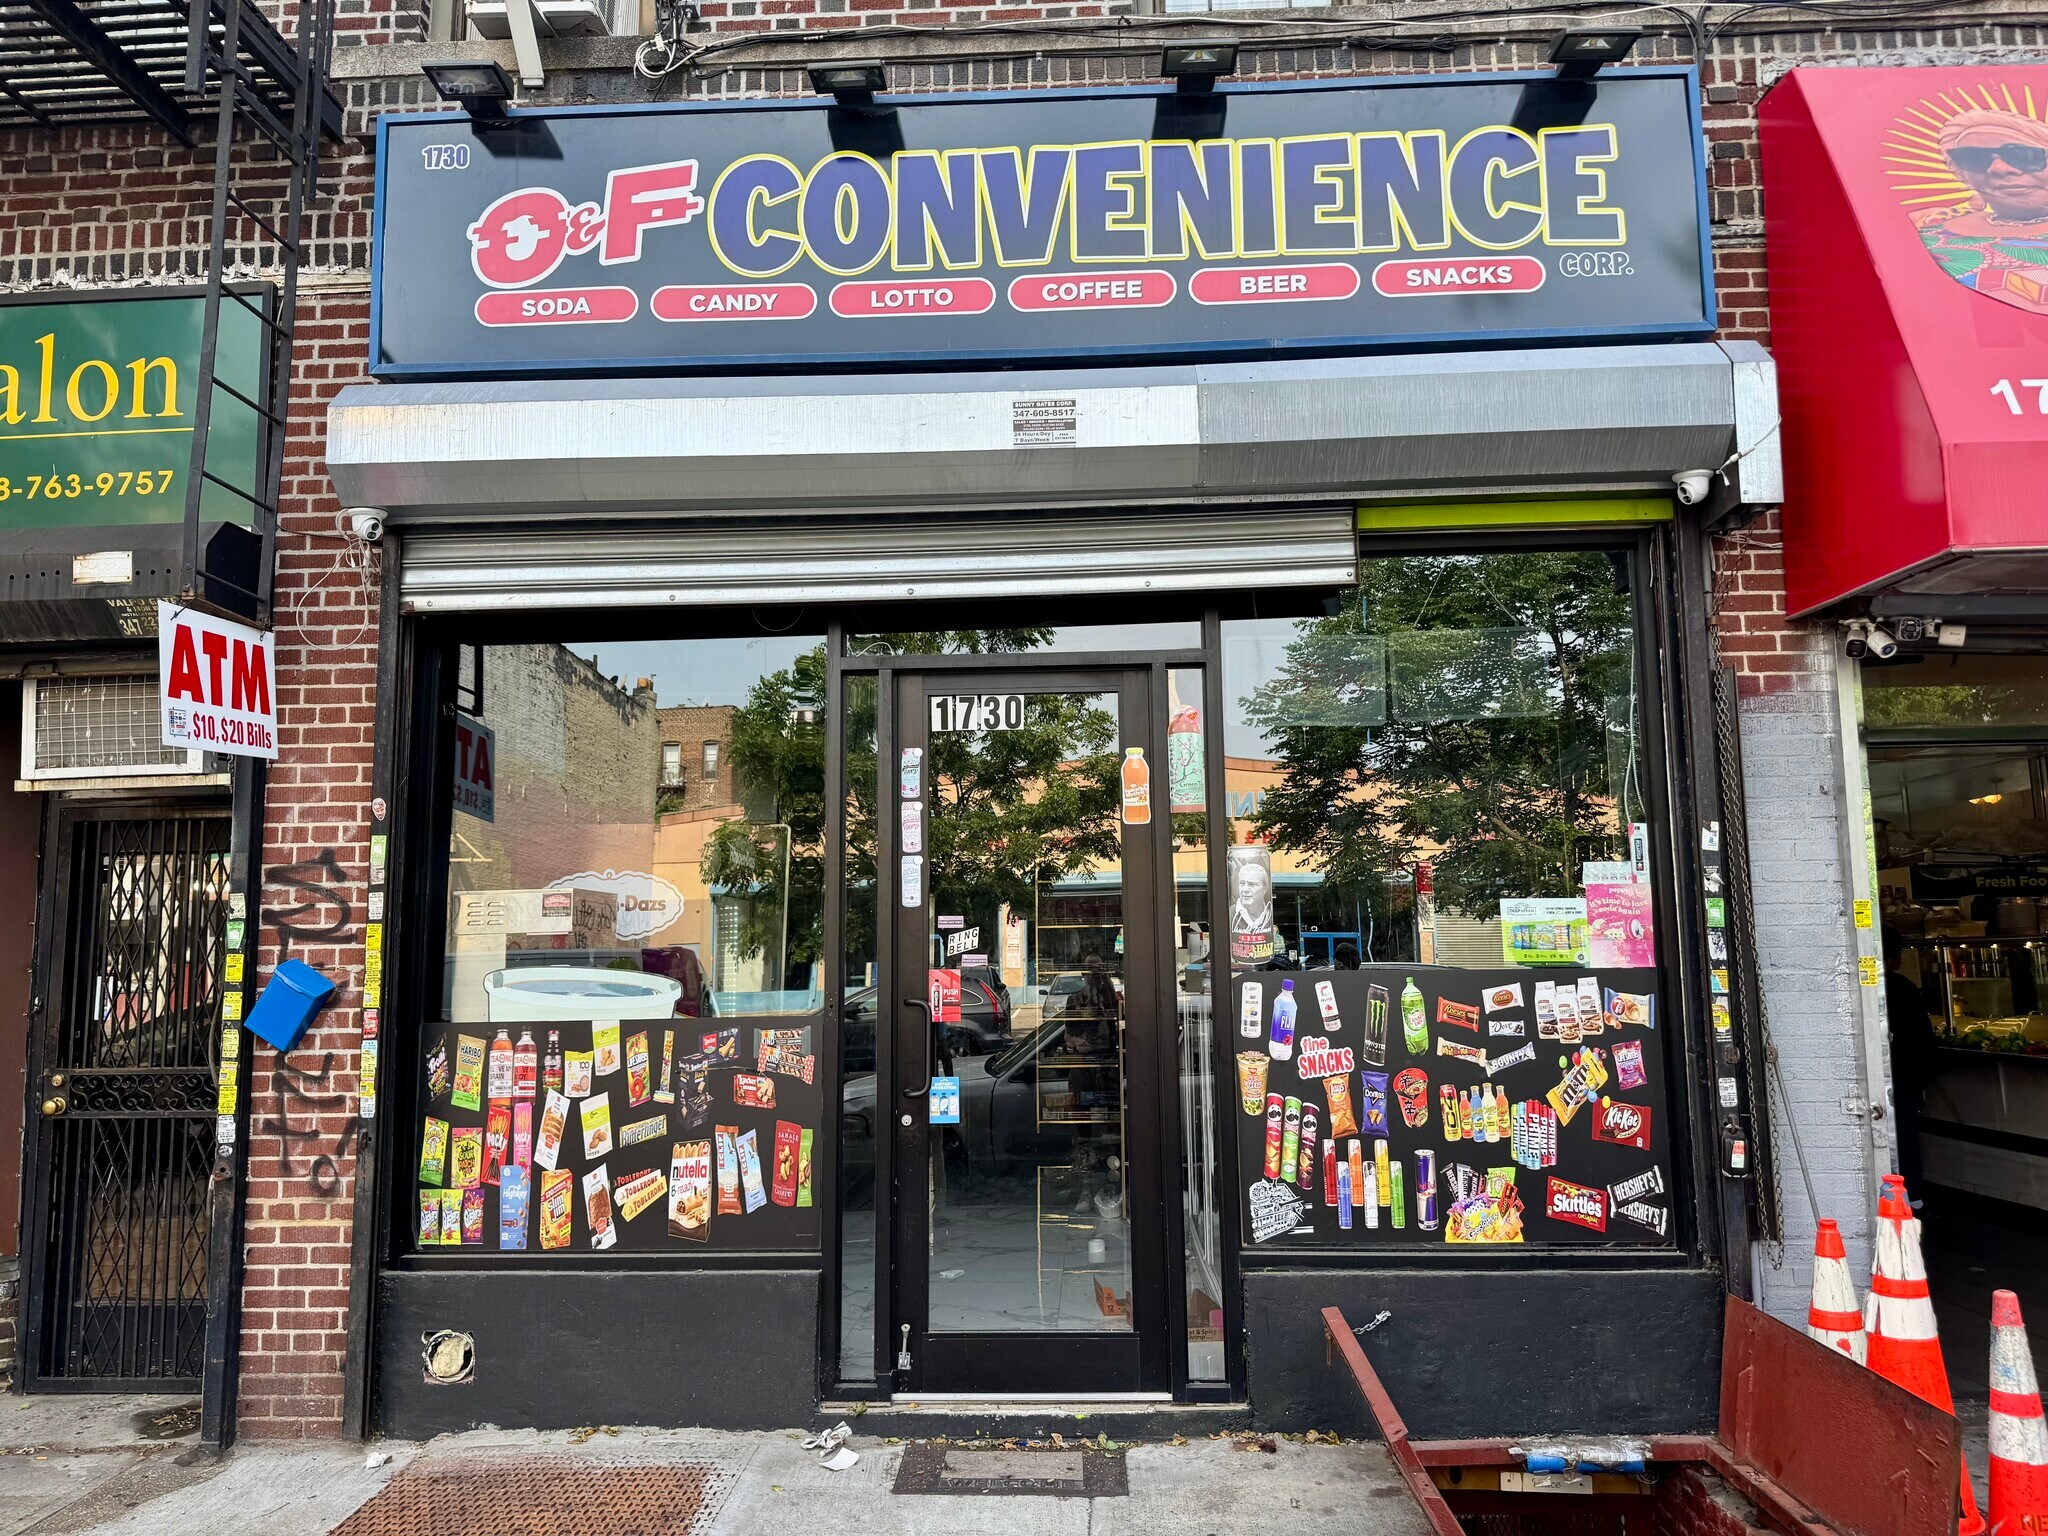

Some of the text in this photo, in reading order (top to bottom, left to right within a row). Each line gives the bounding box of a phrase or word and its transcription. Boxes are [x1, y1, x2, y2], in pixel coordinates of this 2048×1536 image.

[422, 144, 470, 169] 1730
[467, 124, 1626, 289] O&F CONVENIENCE
[1560, 251, 1634, 277] CORP.
[1240, 274, 1307, 294] BEER
[1406, 265, 1512, 286] SNACKS
[870, 287, 953, 308] LOTTO
[1041, 280, 1142, 301] COFFEE
[521, 298, 591, 317] SODA
[689, 293, 778, 313] CANDY
[1013, 408, 1075, 418] 347-605-8517
[120, 618, 143, 635] 347
[168, 623, 271, 716] ATM
[936, 696, 1022, 730] 1730
[247, 722, 272, 750] Bills
[1976, 876, 2048, 887] Fresh Foo
[949, 928, 978, 945] RING
[949, 940, 977, 954] BELL
[943, 988, 959, 996] PUSH
[461, 1043, 481, 1058] HARIBO
[1302, 1038, 1328, 1052] fine
[1299, 1050, 1353, 1077] SNACKS
[1491, 1048, 1526, 1070] BOUNTY
[1528, 1113, 1540, 1159] PRIME
[1540, 1116, 1548, 1156] PRIME
[1548, 1119, 1556, 1157] PRIME
[616, 1168, 652, 1186] TOBLERONE
[672, 1159, 707, 1180] nutella
[624, 1175, 658, 1199] TOBLERONE
[1613, 1170, 1656, 1202] HERSHEY'S
[632, 1182, 664, 1212] TOBLERONE
[1553, 1193, 1602, 1218] Skittles
